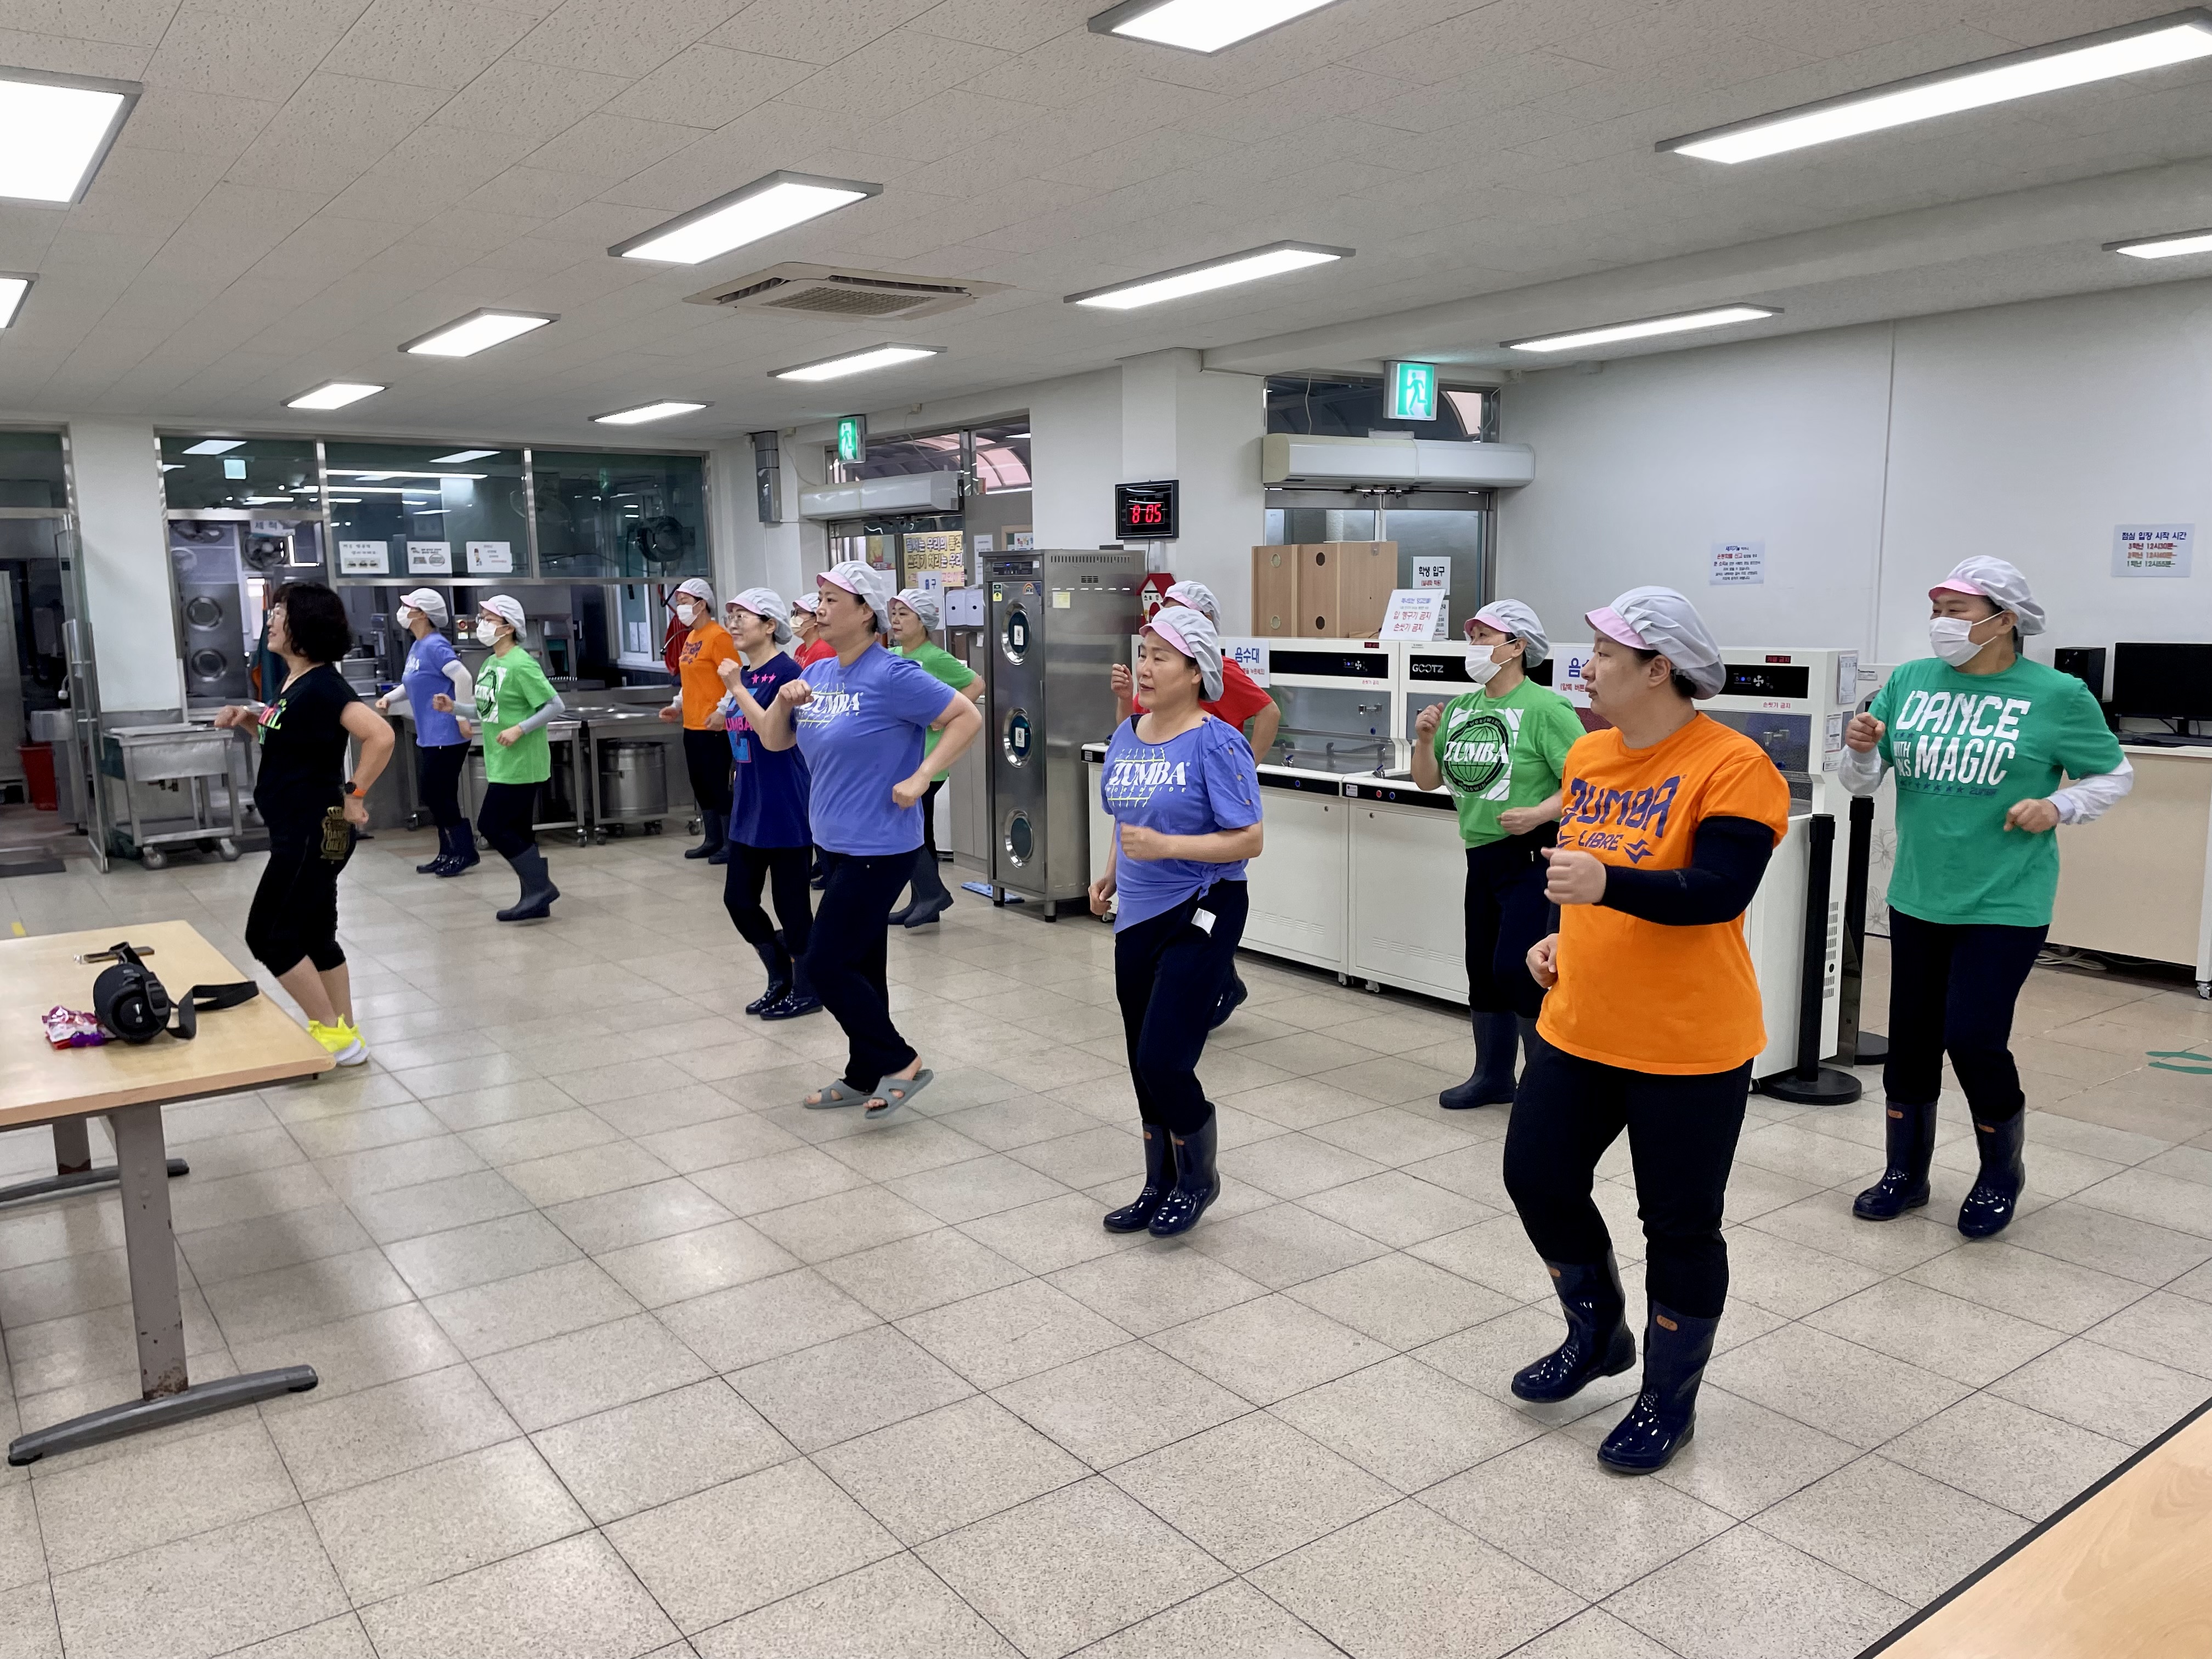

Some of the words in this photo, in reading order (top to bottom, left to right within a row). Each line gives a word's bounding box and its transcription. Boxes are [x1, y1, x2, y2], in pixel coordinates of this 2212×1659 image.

[906, 537, 926, 553] 질서는
[927, 536, 947, 552] 우리의
[2122, 532, 2135, 540] 점심
[2138, 532, 2153, 540] 입장
[2155, 532, 2170, 540] 시작
[2172, 532, 2187, 540] 시간
[907, 554, 927, 569] 쓰레기
[928, 553, 948, 569] 처리는
[949, 552, 964, 568] 우리
[1419, 566, 1430, 577] 학생
[1433, 566, 1445, 577] 입구
[1393, 611, 1400, 619] 입
[1419, 611, 1431, 620] 금지
[1412, 623, 1424, 632] 금지
[1235, 647, 1260, 663] 음수대
[1568, 658, 1590, 678] 음
[1895, 690, 2032, 741] DANCE
[1443, 741, 1510, 764] ZUMBA
[1915, 735, 2016, 786] MAGIC
[1109, 761, 1187, 786] ZUMBA
[1559, 775, 1680, 838] ZUMBA
[1578, 830, 1624, 851] LIBRE
